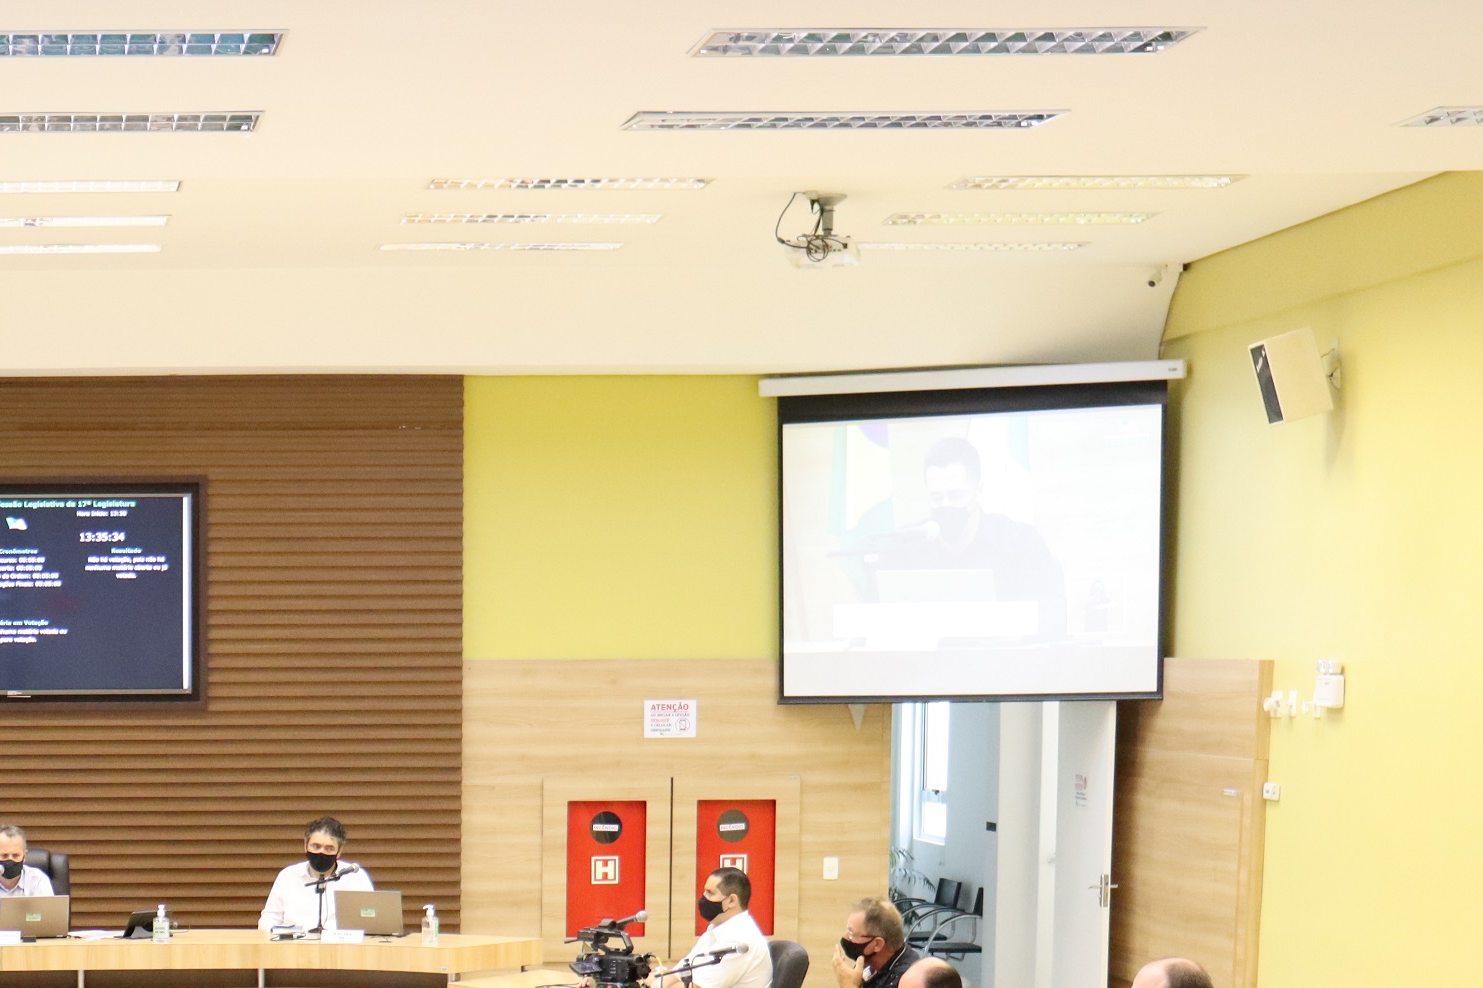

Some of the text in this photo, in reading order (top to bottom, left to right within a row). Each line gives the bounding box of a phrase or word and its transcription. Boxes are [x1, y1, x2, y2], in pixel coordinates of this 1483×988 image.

[24, 500, 65, 509] Legislativa
[93, 500, 136, 508] Legislatura
[80, 532, 125, 542] 13:35:34
[651, 701, 689, 712] ATENÇÃO
[596, 860, 615, 880] H
